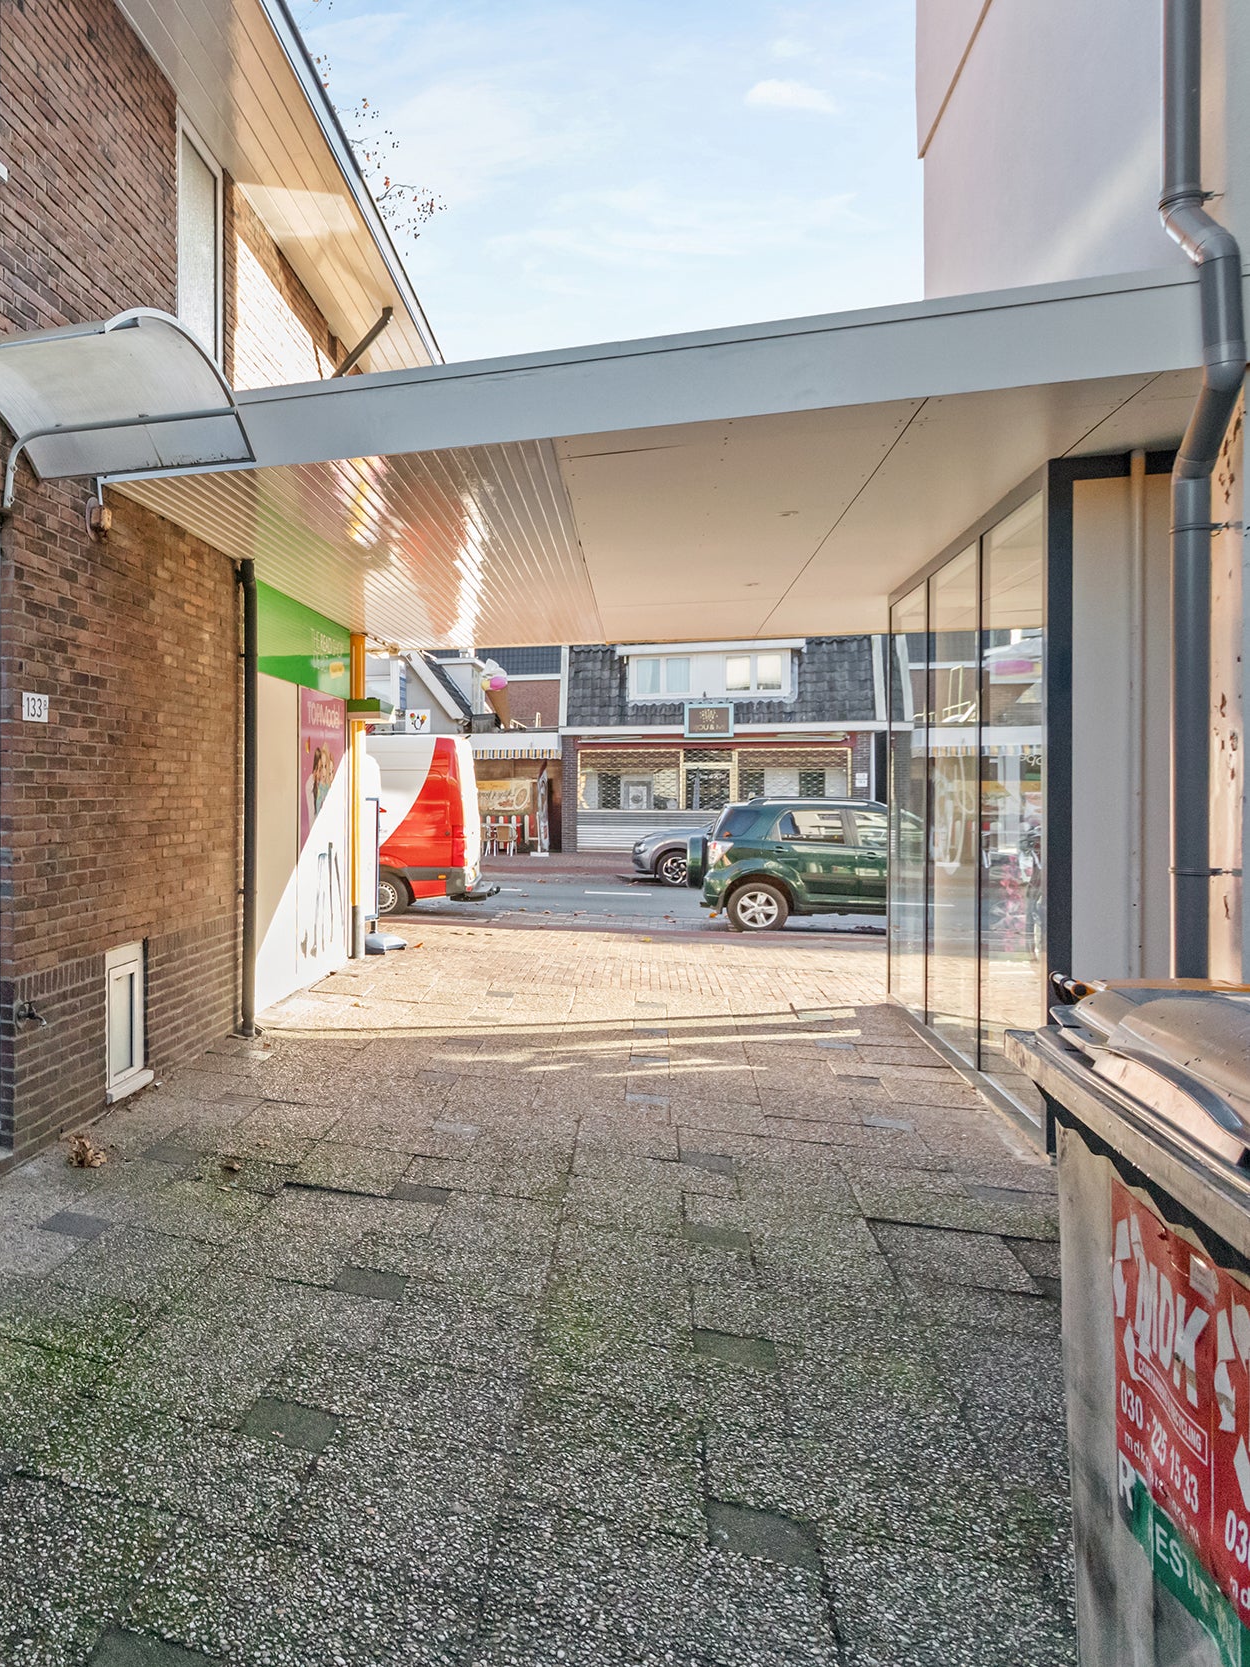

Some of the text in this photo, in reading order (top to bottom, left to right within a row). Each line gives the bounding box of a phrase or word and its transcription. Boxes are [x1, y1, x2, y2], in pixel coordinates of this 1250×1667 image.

[1120, 1380, 1144, 1430] 030
[1170, 1445, 1181, 1490] 15
[1183, 1465, 1199, 1514] 33
[1224, 1509, 1250, 1572] 03
